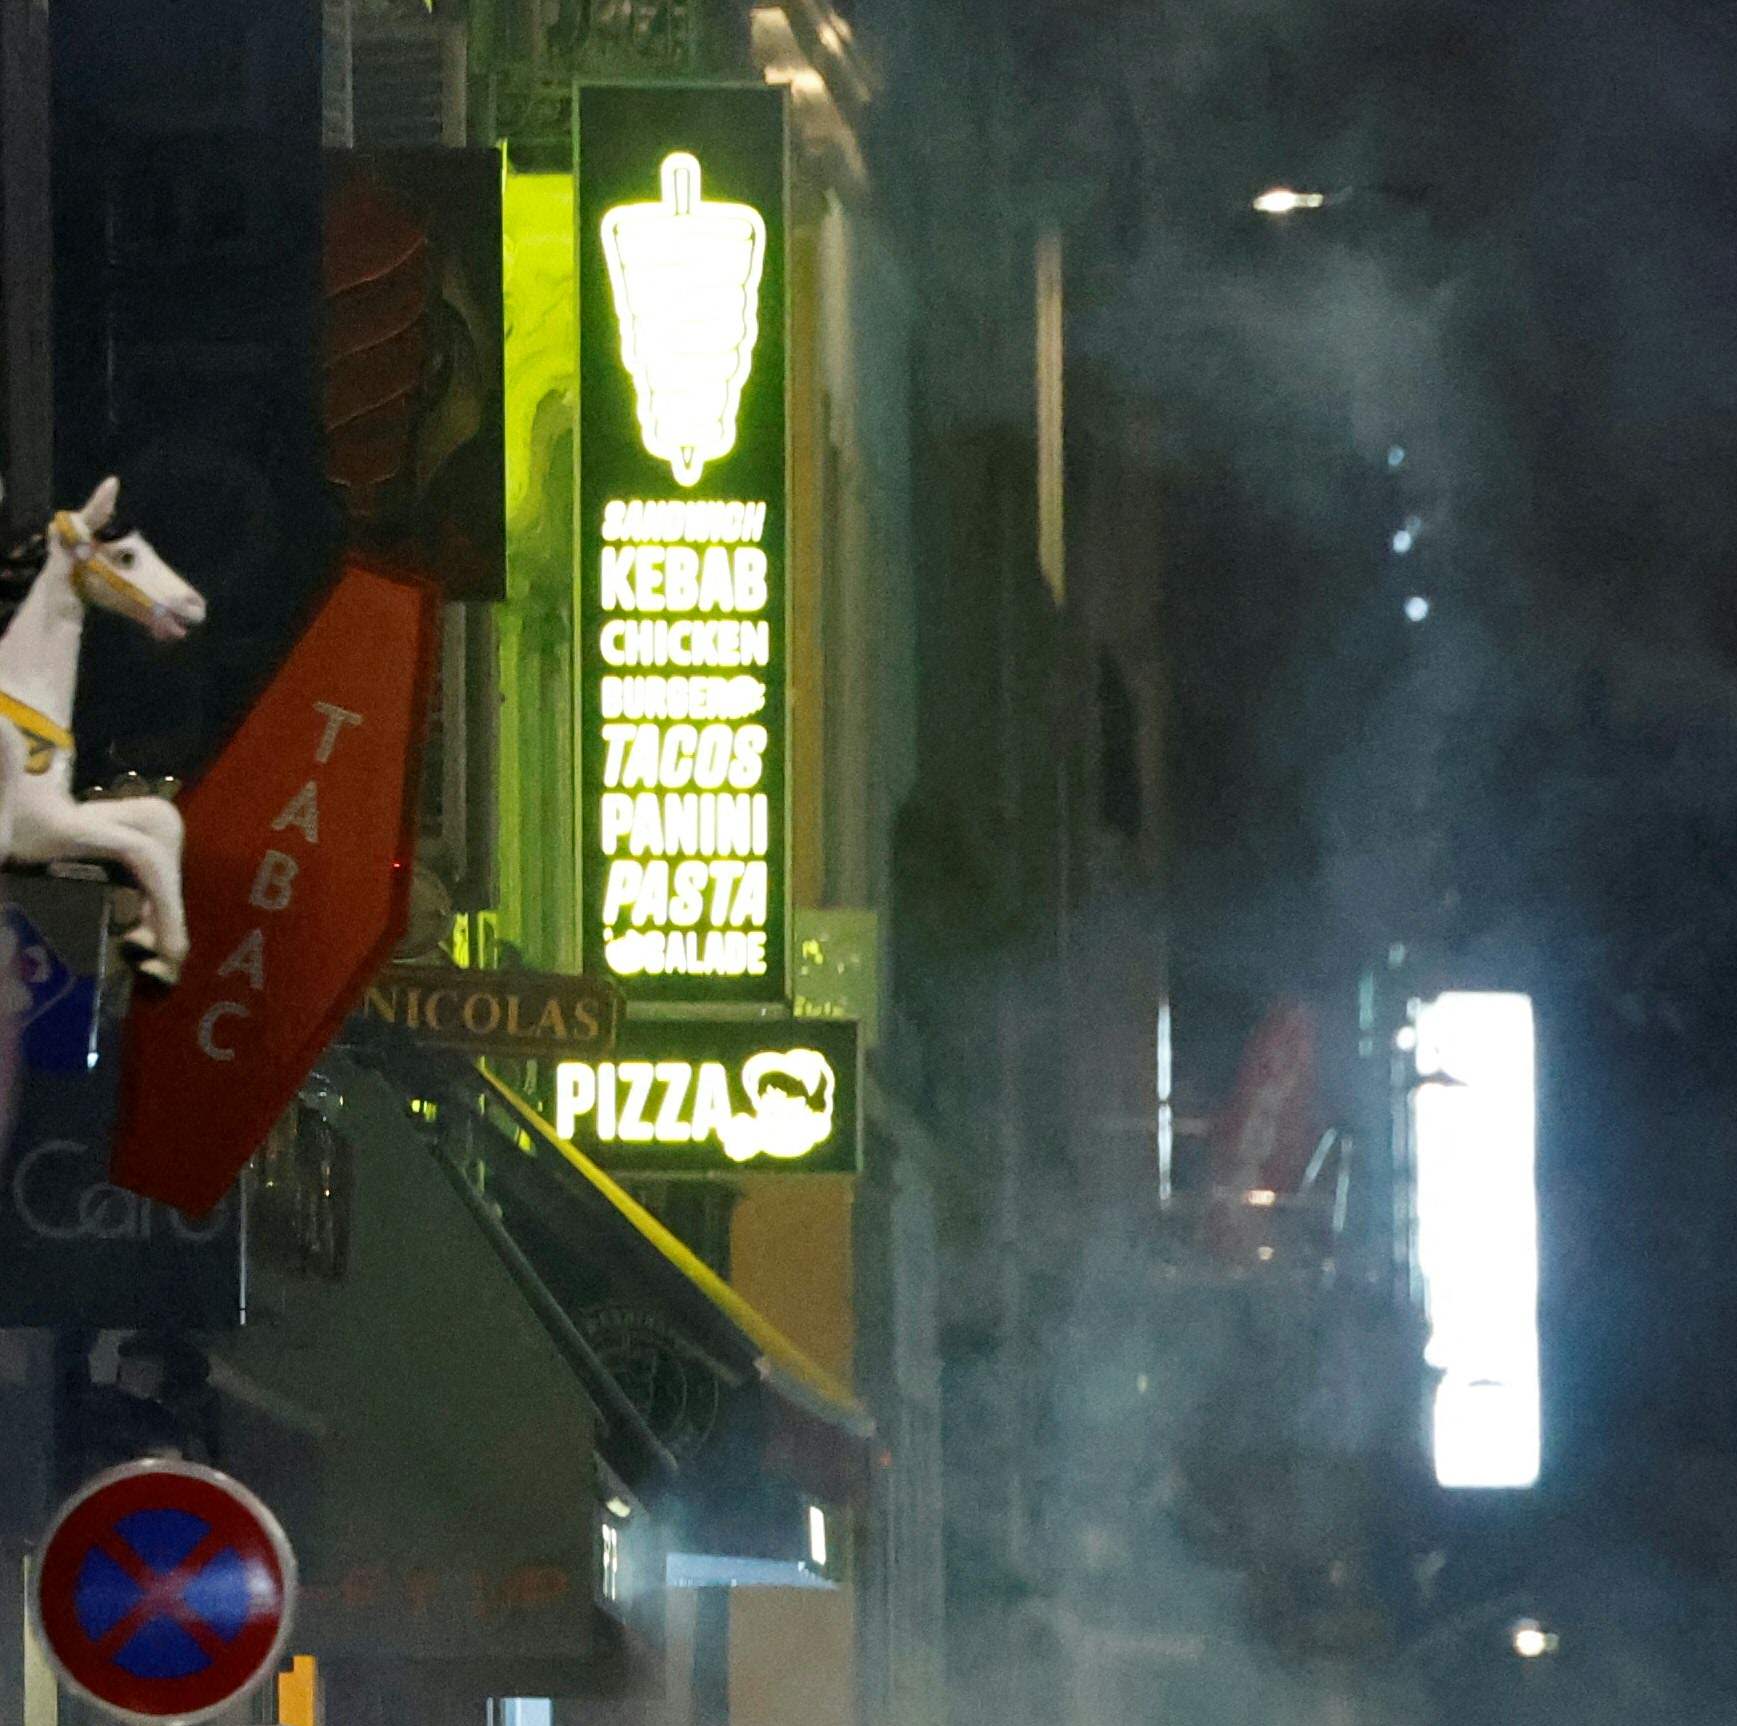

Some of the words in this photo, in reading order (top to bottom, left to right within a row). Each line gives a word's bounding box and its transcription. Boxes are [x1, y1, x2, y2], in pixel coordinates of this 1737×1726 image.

[601, 500, 767, 543] SANDWICH
[601, 545, 768, 613] KEBAB
[600, 619, 770, 668] CHICKEN
[601, 723, 768, 789] TACOS
[601, 792, 768, 857] PANINI
[197, 701, 364, 1062] TABAC
[602, 859, 768, 927] PASTA
[646, 931, 767, 974] SALADE
[363, 986, 600, 1041] NICOLAS
[555, 1061, 734, 1142] PIZZA
